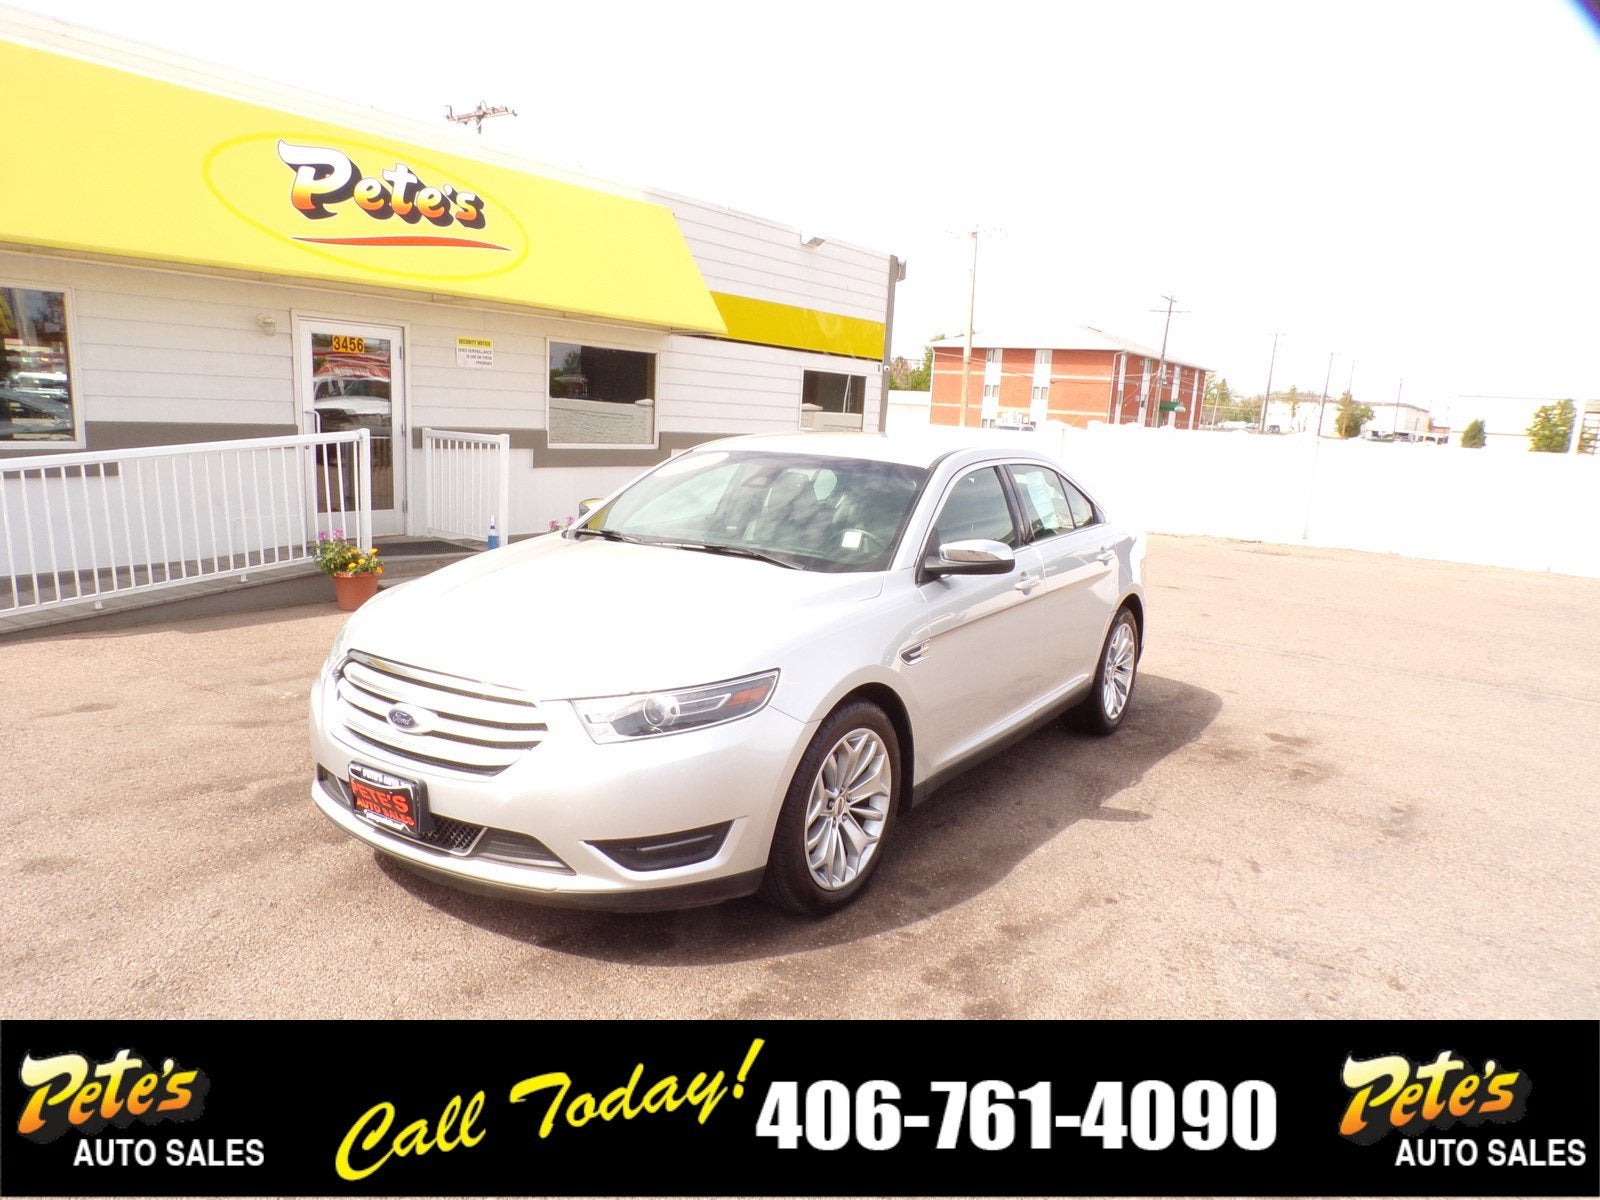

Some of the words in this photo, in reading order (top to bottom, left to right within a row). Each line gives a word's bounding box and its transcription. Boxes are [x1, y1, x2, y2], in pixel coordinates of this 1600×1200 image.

[278, 139, 486, 230] Pete's
[333, 336, 364, 353] 3456
[351, 779, 408, 813] PETE'S
[356, 797, 381, 814] AUTO
[381, 807, 415, 826] SALES
